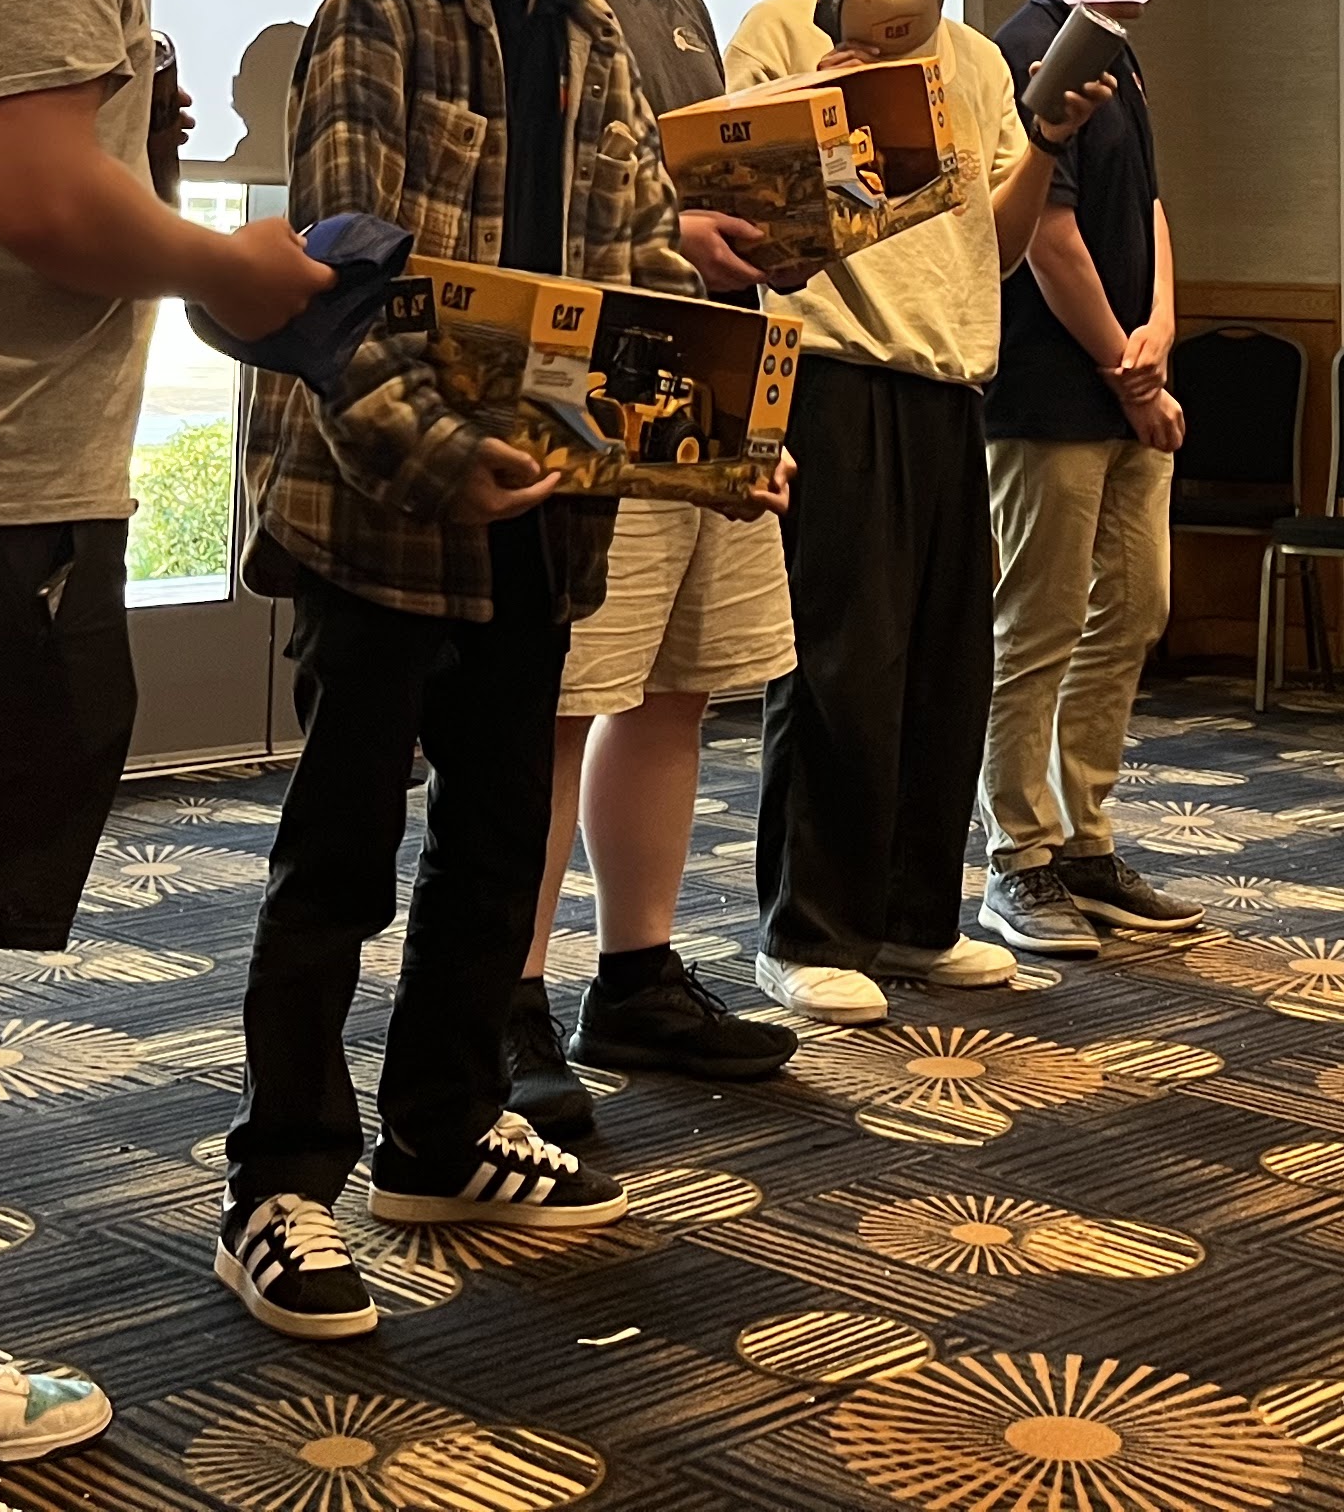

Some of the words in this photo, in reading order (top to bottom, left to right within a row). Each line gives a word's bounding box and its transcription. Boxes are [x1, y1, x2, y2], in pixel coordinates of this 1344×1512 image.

[822, 105, 838, 129] CAT
[719, 120, 752, 144] CAT
[392, 294, 428, 319] CAT
[441, 281, 476, 311] CAT
[551, 303, 585, 332] CAT
